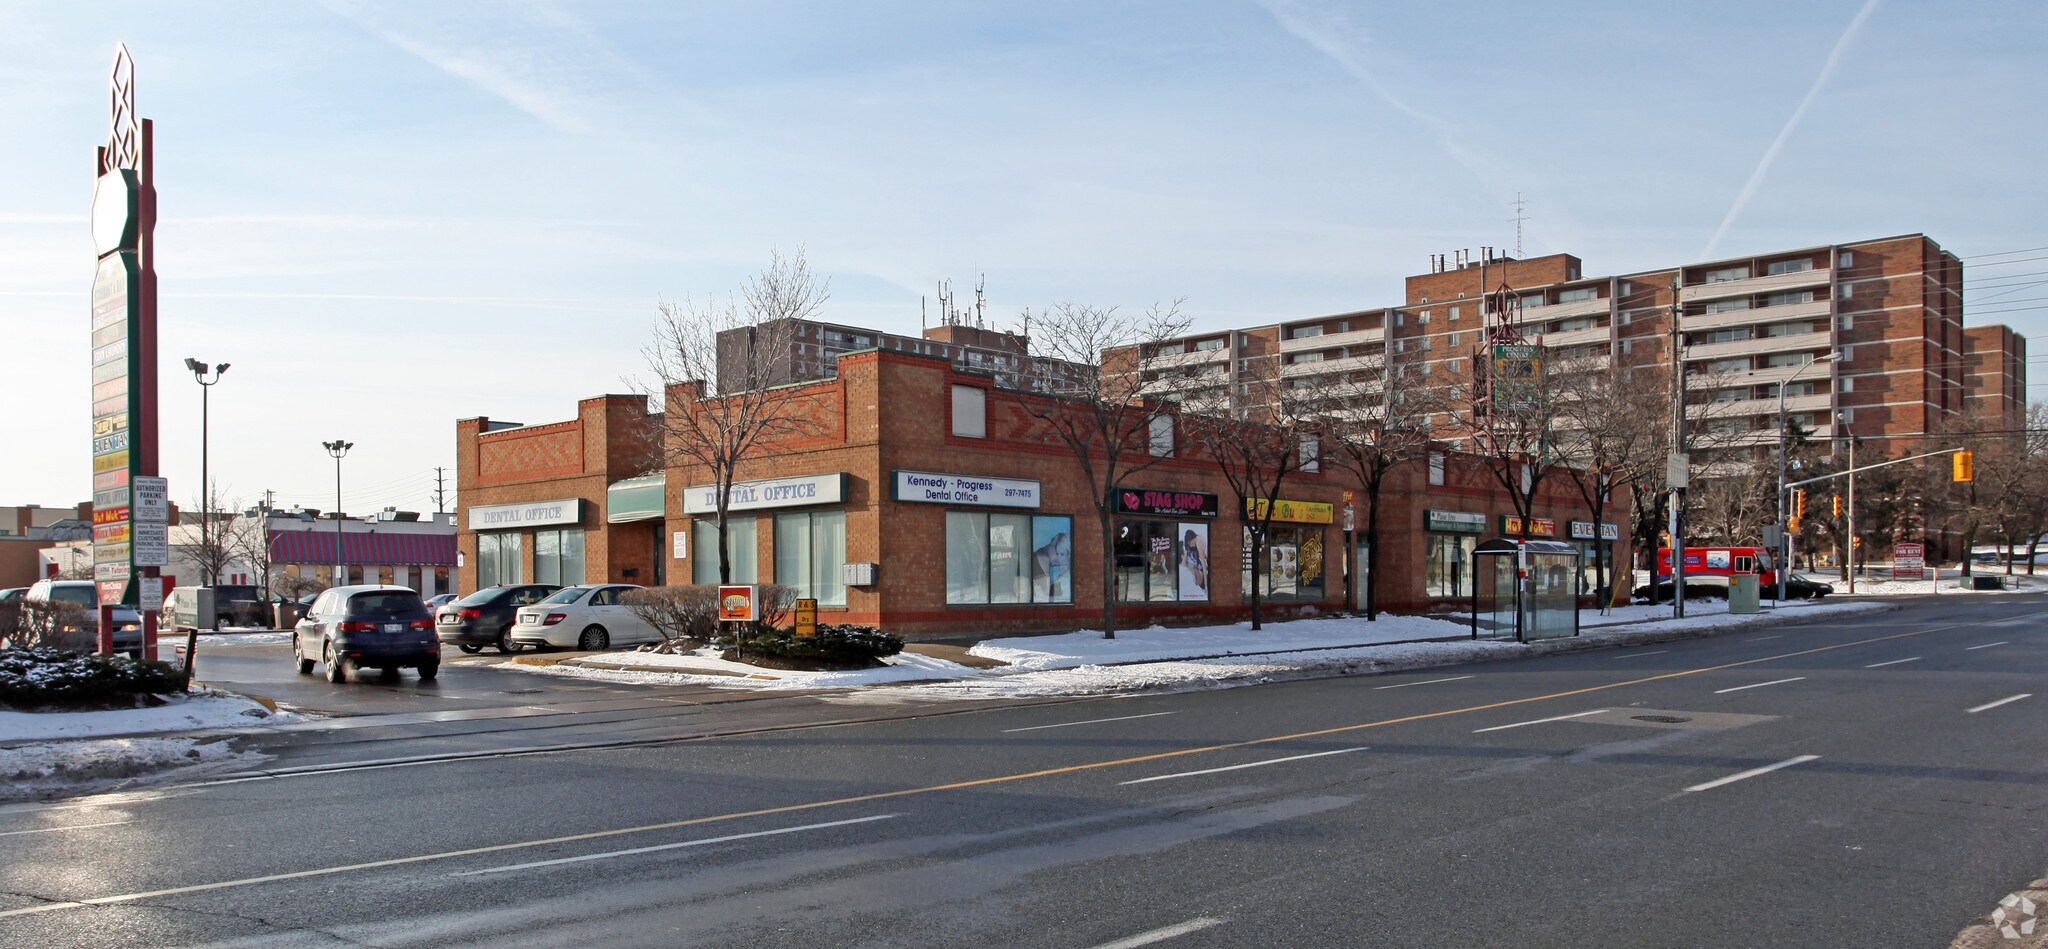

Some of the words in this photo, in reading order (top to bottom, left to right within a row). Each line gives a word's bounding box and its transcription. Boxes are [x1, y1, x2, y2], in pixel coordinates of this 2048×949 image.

[136, 484, 166, 493] AUTHORIZED
[907, 475, 948, 489] Kennedy
[956, 479, 993, 491] Progress
[139, 491, 162, 499] PARKING
[705, 488, 758, 506] DTAL
[764, 482, 816, 501] OFFICE
[925, 489, 952, 500] Dental
[954, 491, 979, 502] Office
[1004, 488, 1032, 498] 297-7475
[1144, 491, 1172, 508] STAG
[1174, 494, 1204, 509] SHOP
[94, 511, 104, 524] Hot
[105, 510, 119, 523] Wok
[484, 509, 521, 523] DENTAL
[525, 506, 561, 521] OFFICE
[1505, 518, 1521, 532] Hot
[1600, 524, 1617, 537] TAN
